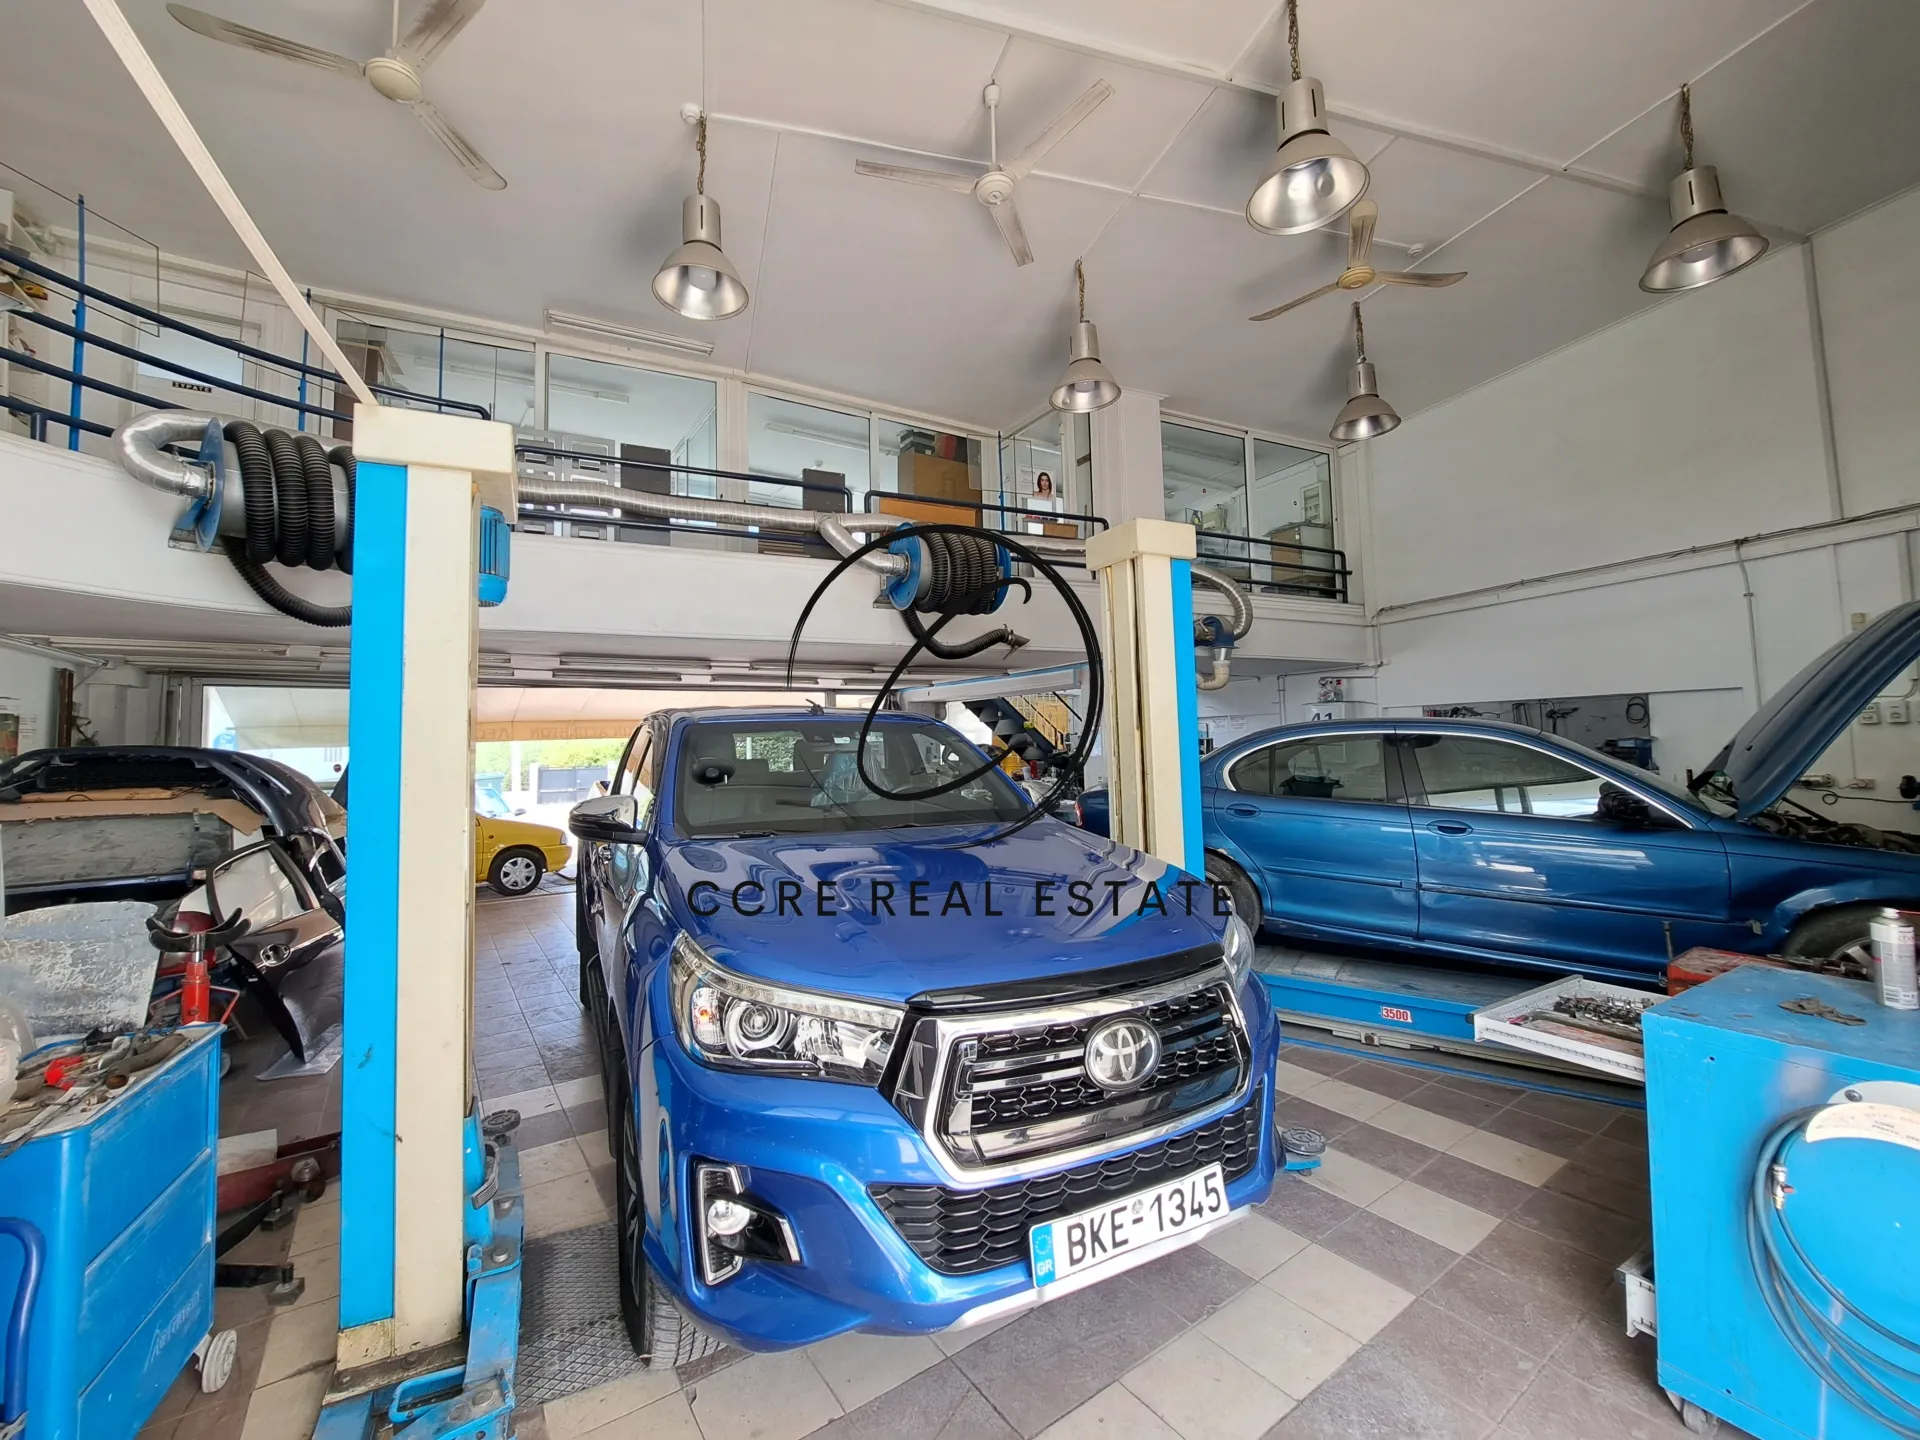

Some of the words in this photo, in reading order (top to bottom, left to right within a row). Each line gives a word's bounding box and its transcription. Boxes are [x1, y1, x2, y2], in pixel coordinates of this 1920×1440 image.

[1383, 1007, 1409, 1021] 3500
[1066, 1171, 1222, 1268] BKE-1345
[1036, 1258, 1054, 1276] GR
